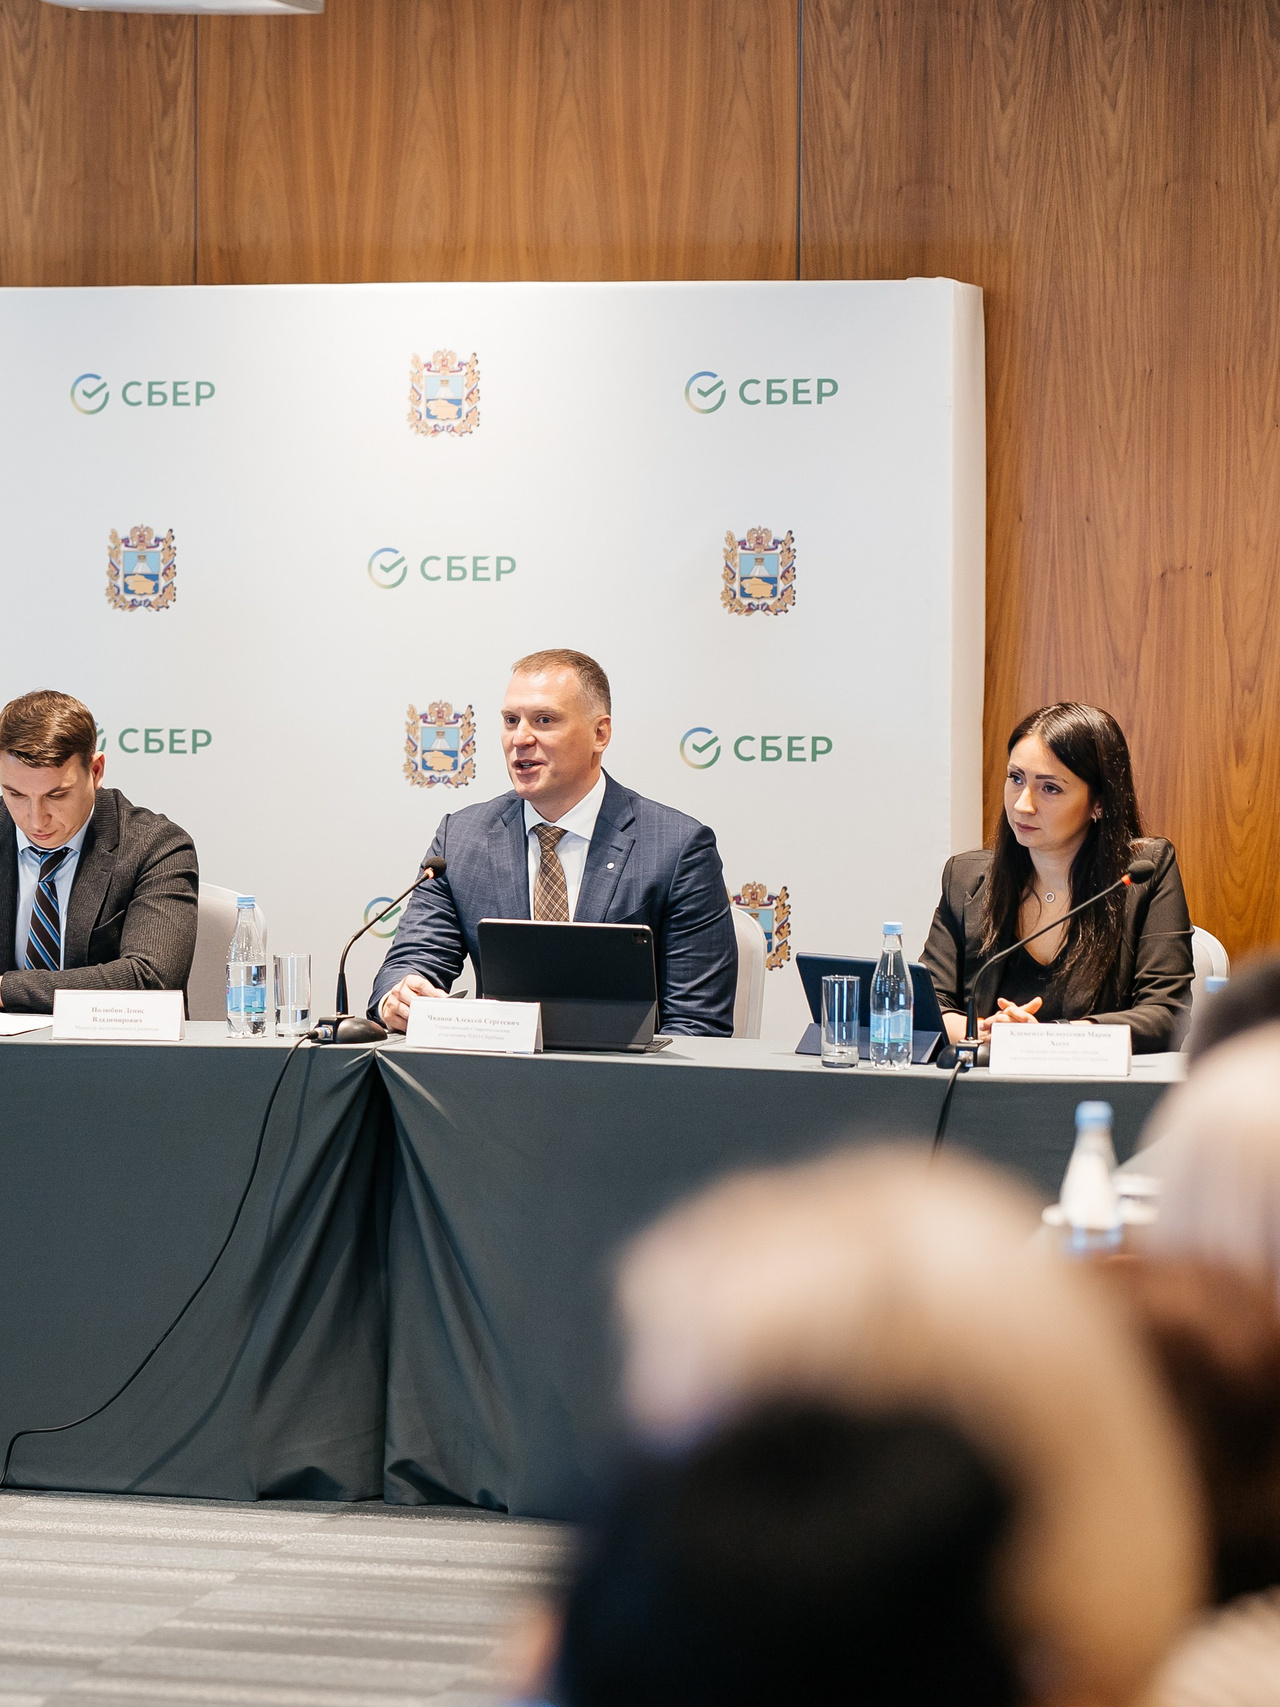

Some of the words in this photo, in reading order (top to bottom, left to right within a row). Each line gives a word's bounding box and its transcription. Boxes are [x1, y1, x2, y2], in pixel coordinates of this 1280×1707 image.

[122, 380, 216, 407] СБЕР
[738, 378, 839, 405] СБЕР
[420, 555, 517, 582] СБЕР
[118, 727, 213, 755] СБЕР
[733, 736, 834, 763] СБЕР
